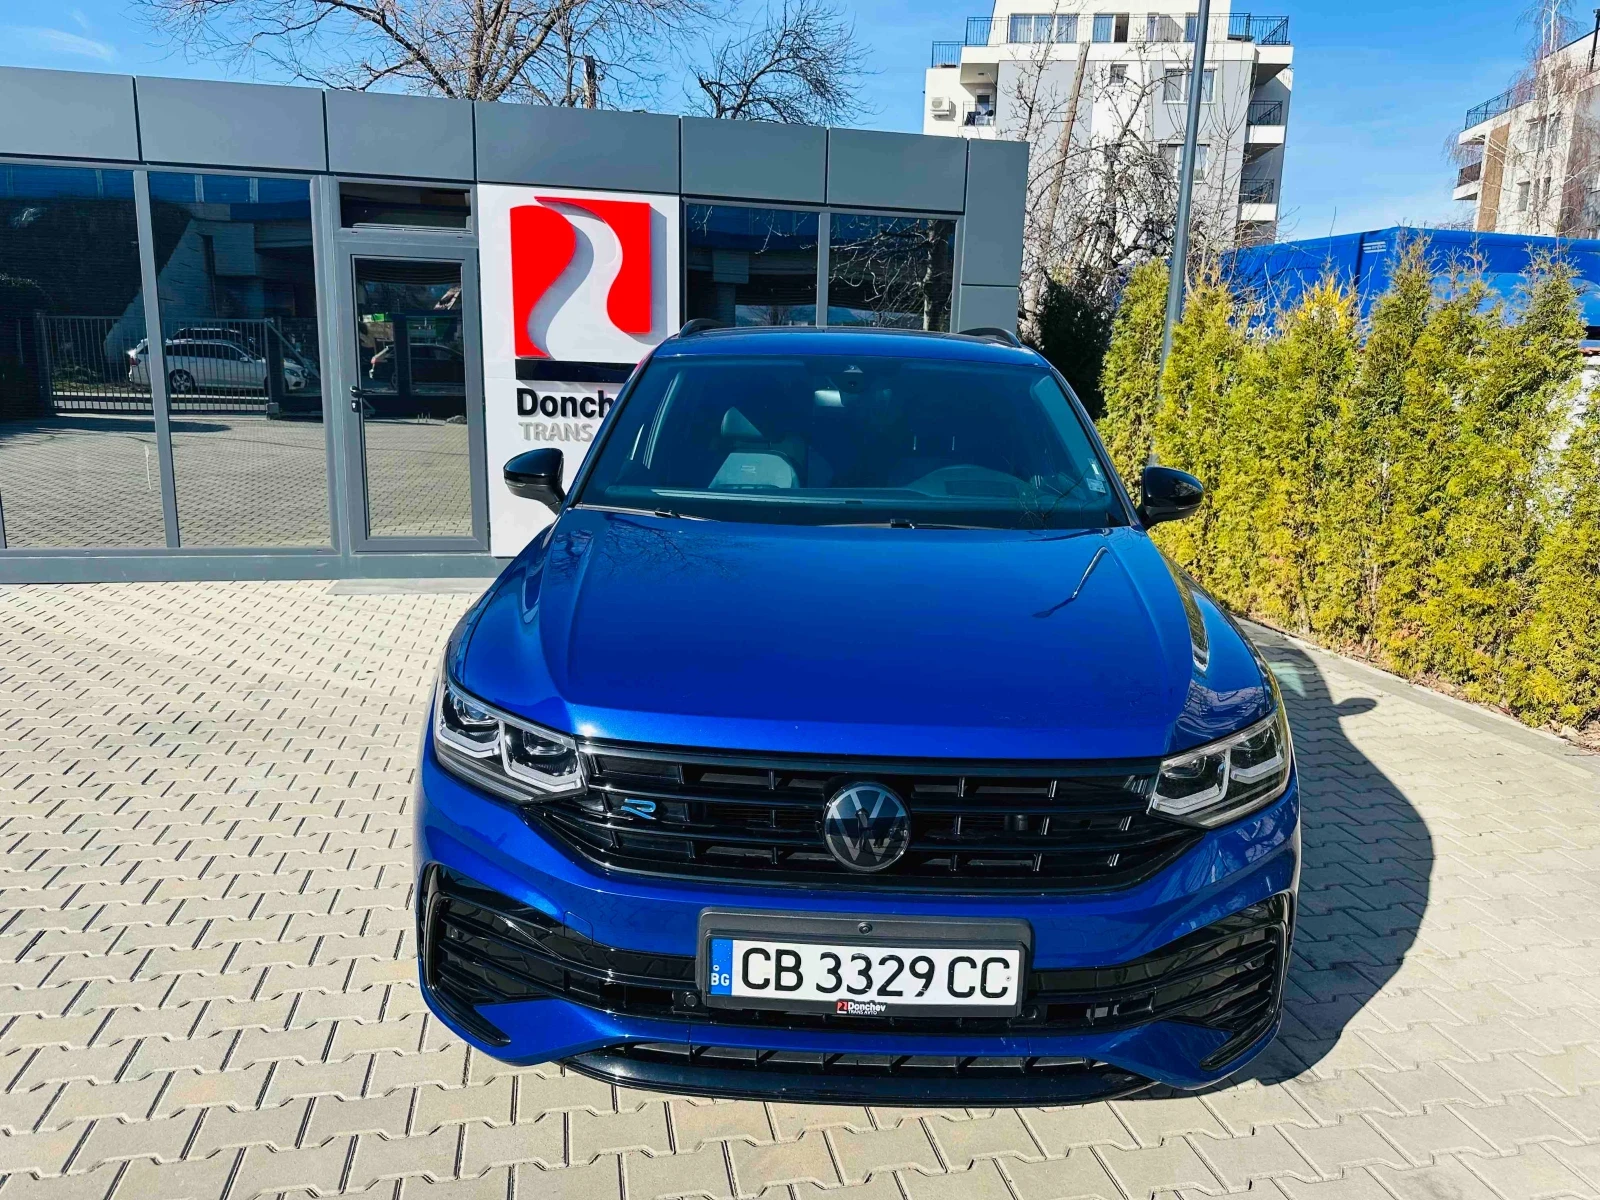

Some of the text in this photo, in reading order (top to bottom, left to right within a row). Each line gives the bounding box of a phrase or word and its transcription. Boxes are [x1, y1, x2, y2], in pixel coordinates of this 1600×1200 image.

[516, 387, 615, 419] Donch
[518, 421, 594, 442] TRANS
[710, 972, 730, 987] BG
[741, 946, 1011, 999] CB 3329 CC
[848, 1002, 887, 1012] Donchev
